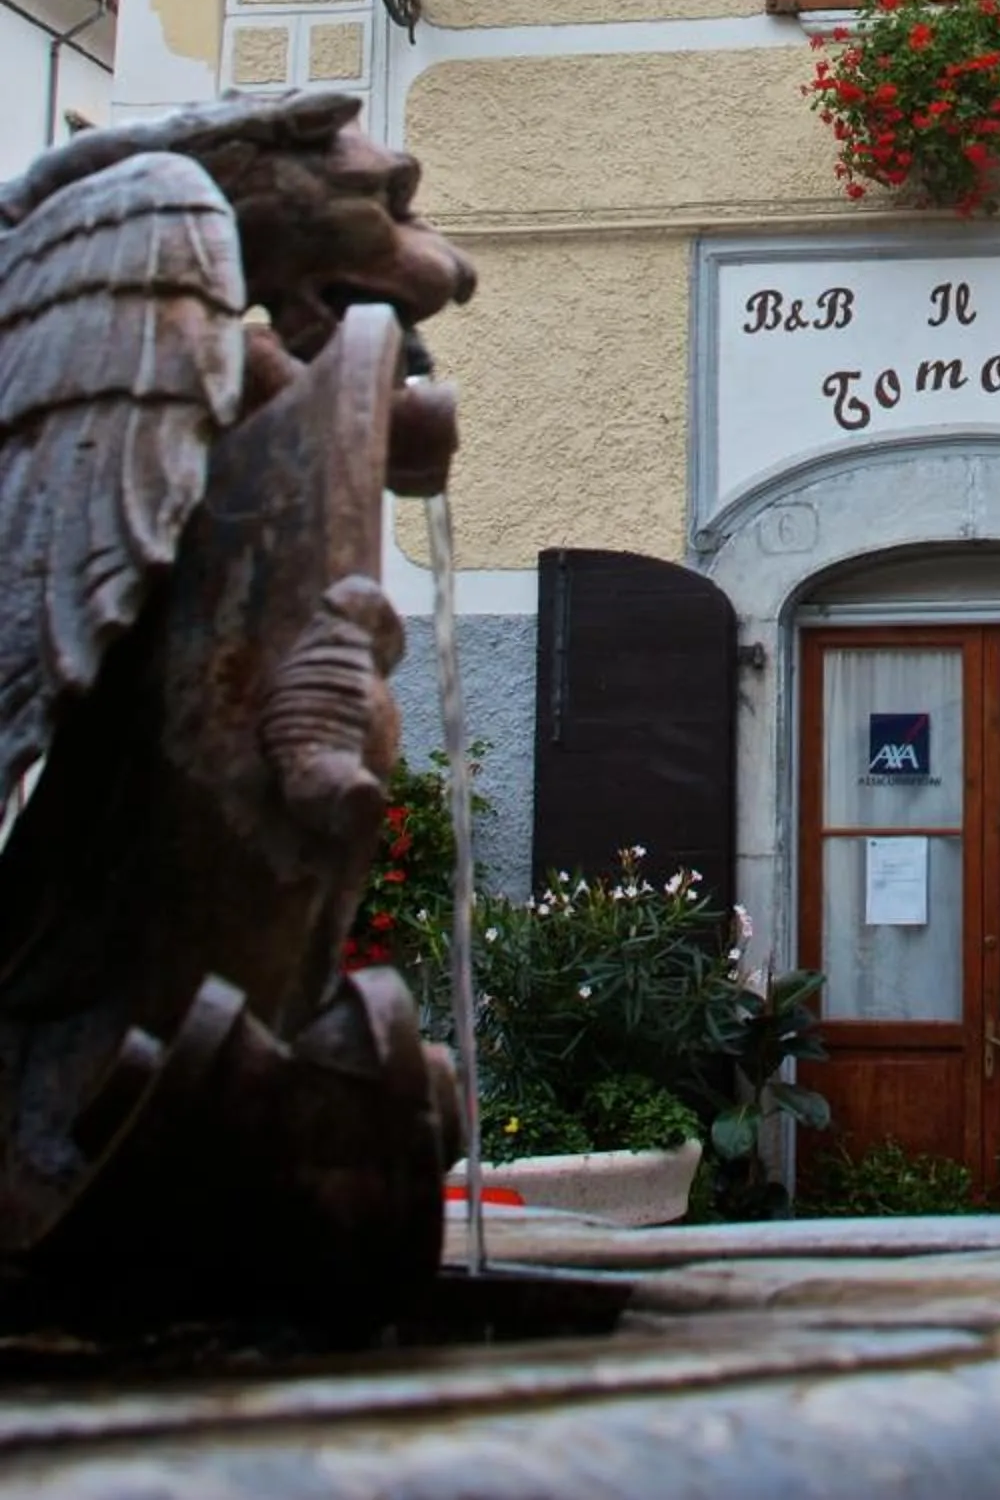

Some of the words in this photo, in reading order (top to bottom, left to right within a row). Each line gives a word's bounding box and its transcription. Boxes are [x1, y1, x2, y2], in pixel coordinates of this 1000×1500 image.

[743, 287, 856, 334] B&B
[927, 282, 977, 328] Il
[868, 743, 920, 769] AXA
